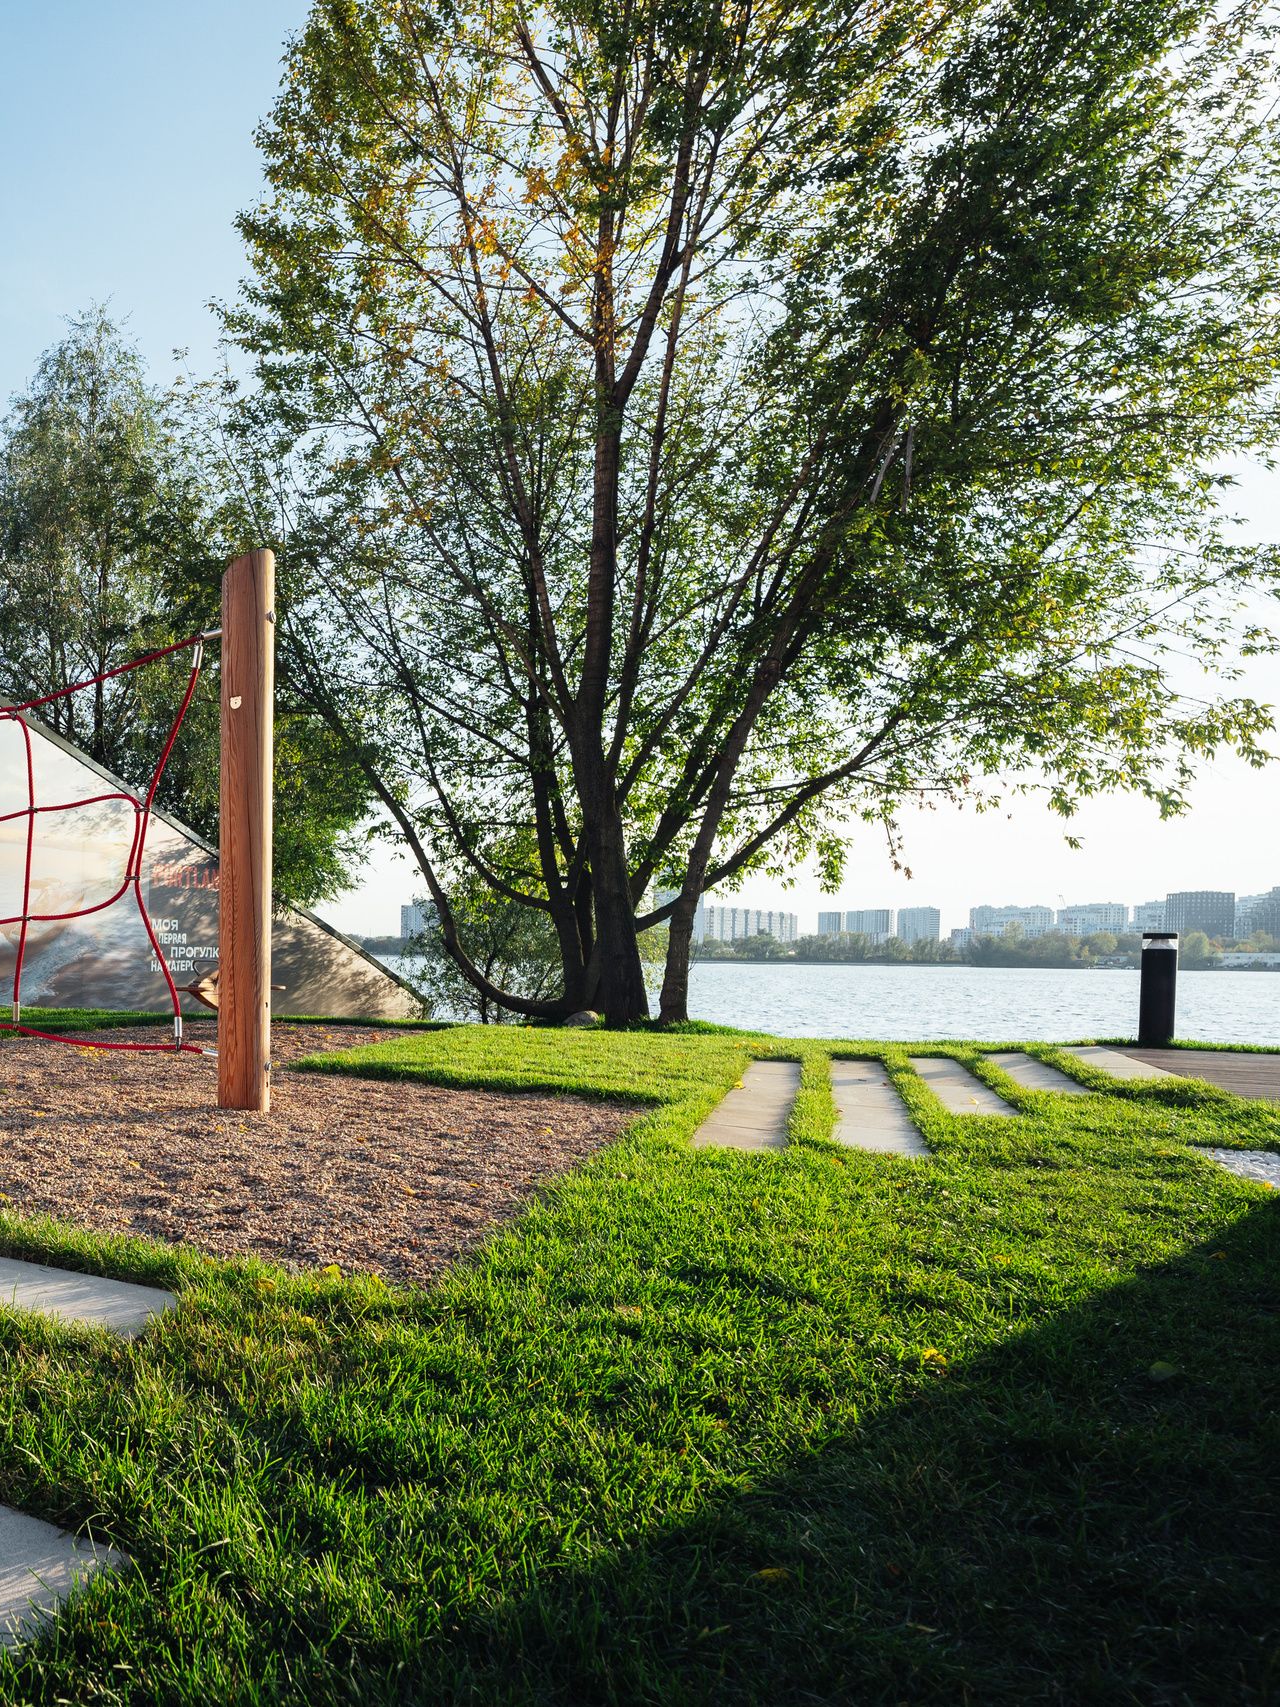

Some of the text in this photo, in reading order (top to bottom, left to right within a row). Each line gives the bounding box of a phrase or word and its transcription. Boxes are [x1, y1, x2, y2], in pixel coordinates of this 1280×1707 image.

[153, 863, 219, 889] PORTLAN
[151, 918, 179, 931] МОЯ
[170, 946, 219, 958] ПРОГУЛК
